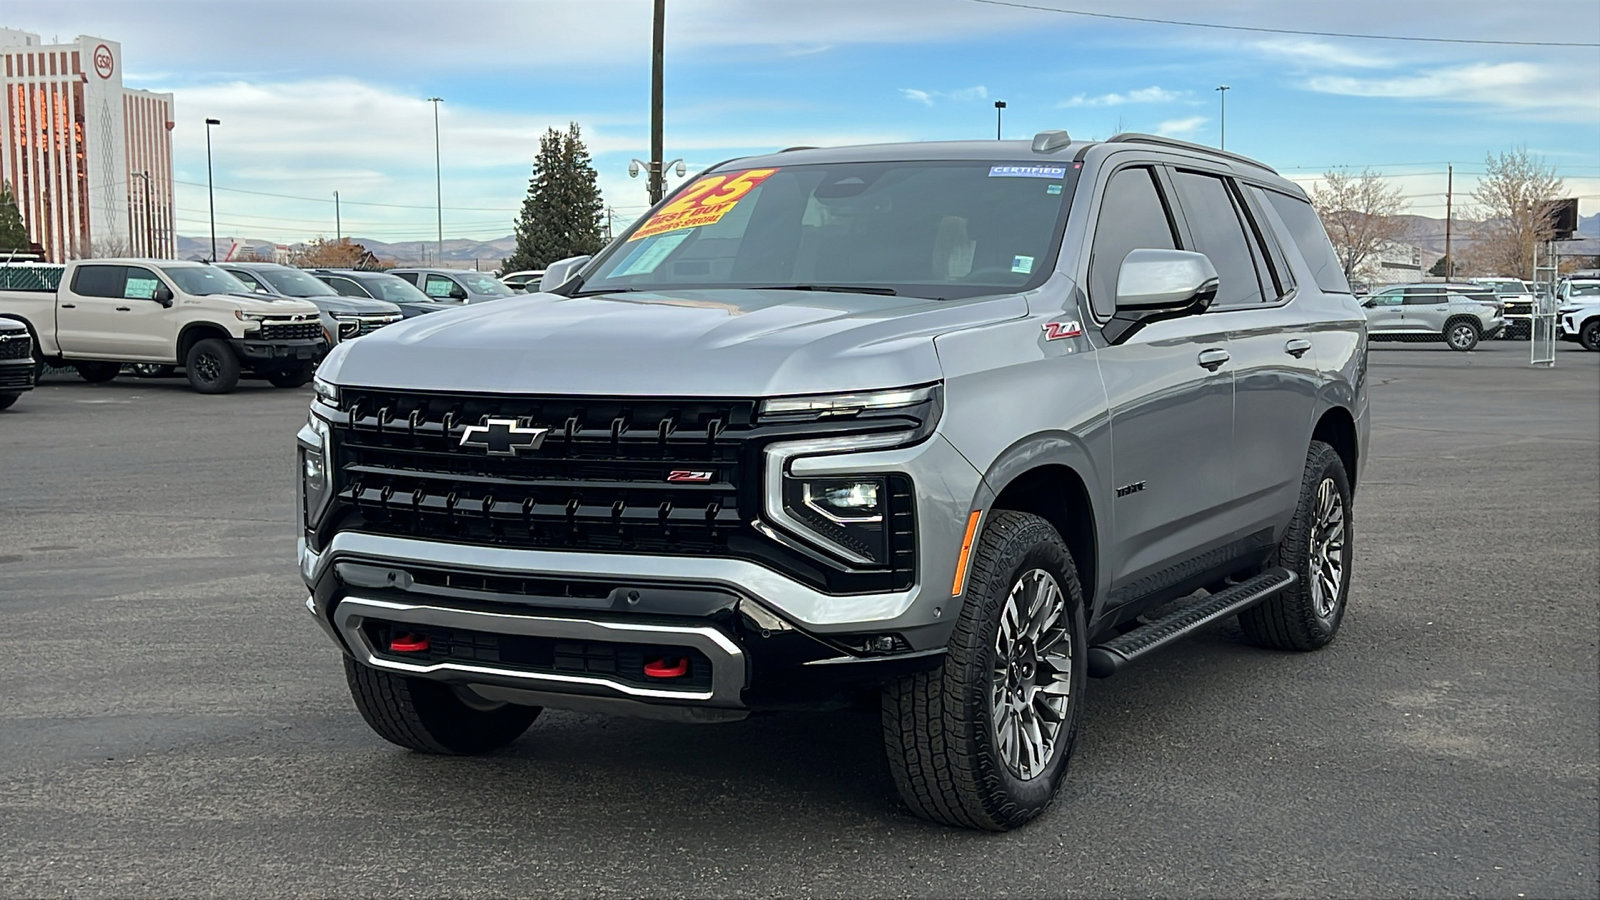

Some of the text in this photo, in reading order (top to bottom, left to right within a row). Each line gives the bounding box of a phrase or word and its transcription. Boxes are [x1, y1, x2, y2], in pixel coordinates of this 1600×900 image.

[96, 54, 111, 70] GSR
[993, 166, 1062, 174] CERTIFIED
[658, 169, 776, 215] 25
[645, 203, 731, 228] BEST BUY
[681, 214, 721, 227] SPECIAL
[1041, 321, 1082, 341] Z71
[667, 471, 713, 482] Z71
